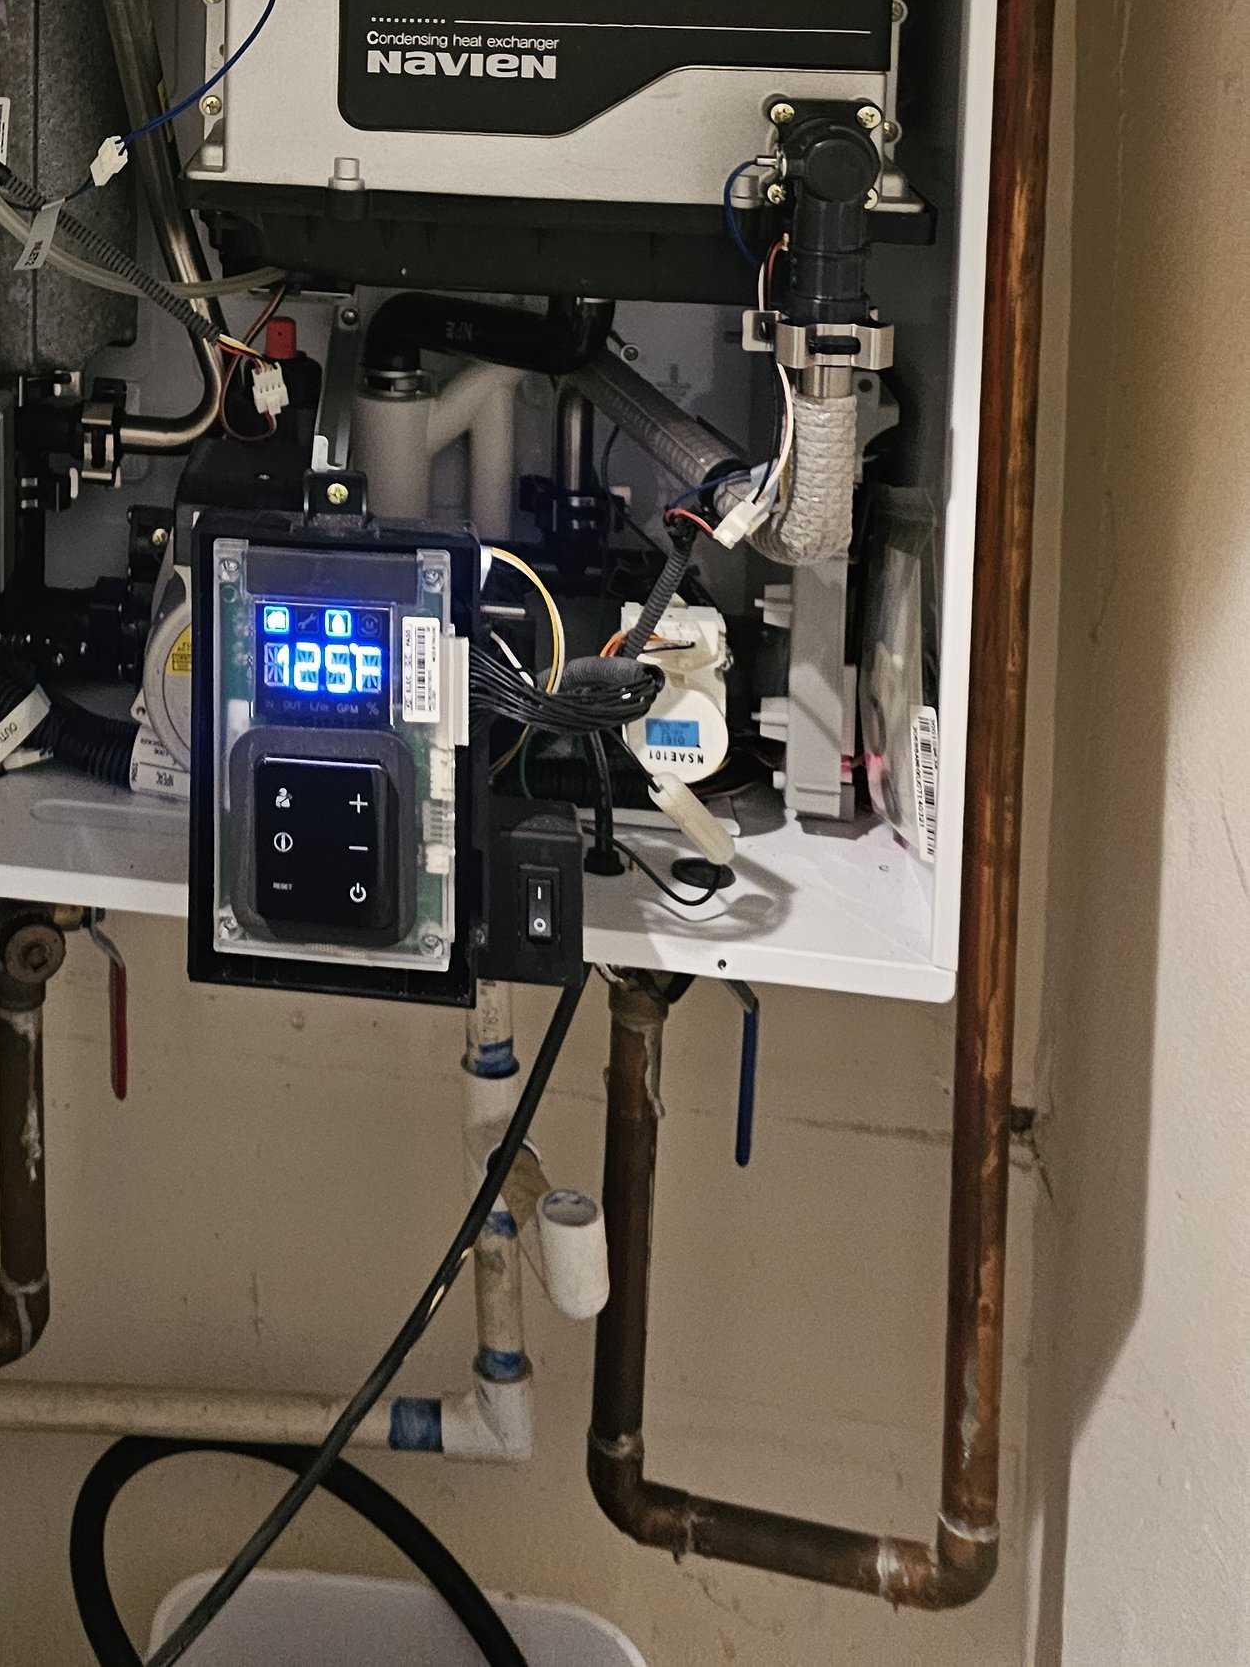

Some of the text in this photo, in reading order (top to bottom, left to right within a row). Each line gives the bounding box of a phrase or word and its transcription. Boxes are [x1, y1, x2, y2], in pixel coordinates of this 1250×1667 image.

[366, 30, 560, 52] Condensing heat exchanger
[336, 702, 359, 714] GPM
[366, 702, 380, 716] %
[649, 749, 704, 764] NSAE101
[273, 881, 292, 891] RESET
